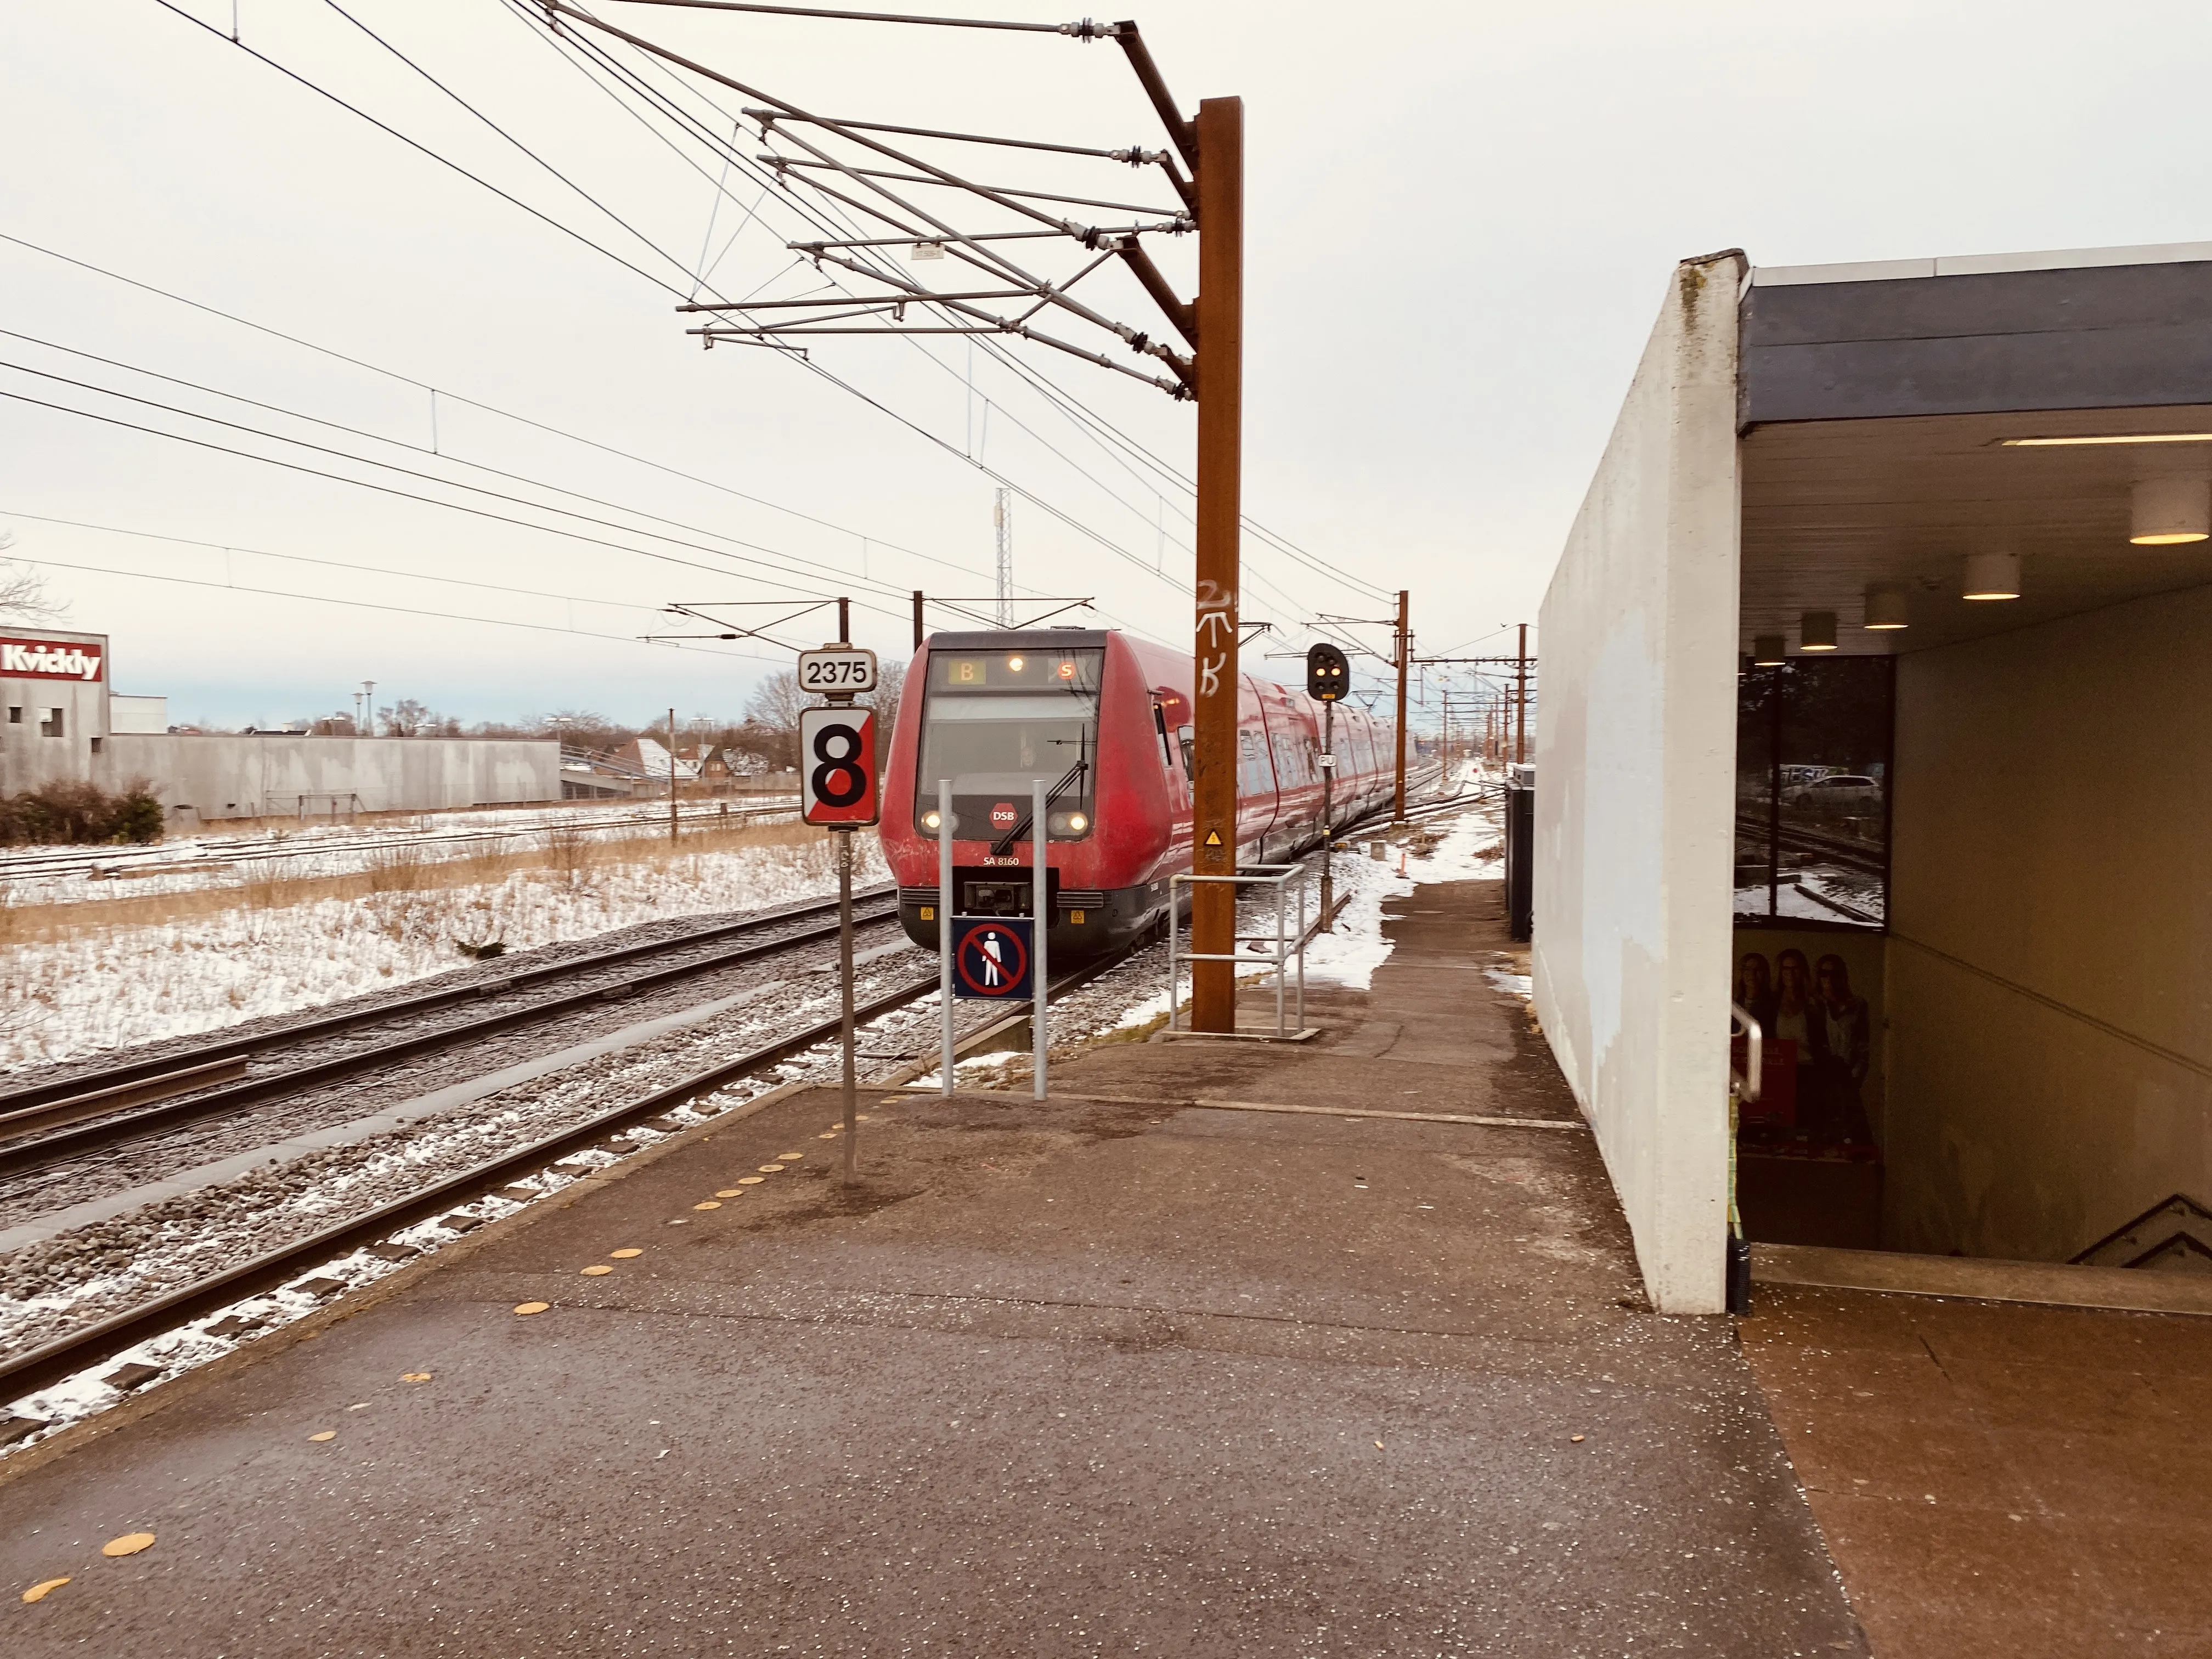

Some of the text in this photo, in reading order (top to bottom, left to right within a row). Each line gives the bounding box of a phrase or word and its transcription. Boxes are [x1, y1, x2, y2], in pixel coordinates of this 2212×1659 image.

[1, 644, 101, 680] Kvickly
[1061, 664, 1072, 676] S
[807, 661, 867, 684] 2375
[961, 663, 974, 681] B
[812, 724, 867, 808] 8
[993, 811, 1014, 821] DSB
[983, 857, 1019, 866] SA 8160
